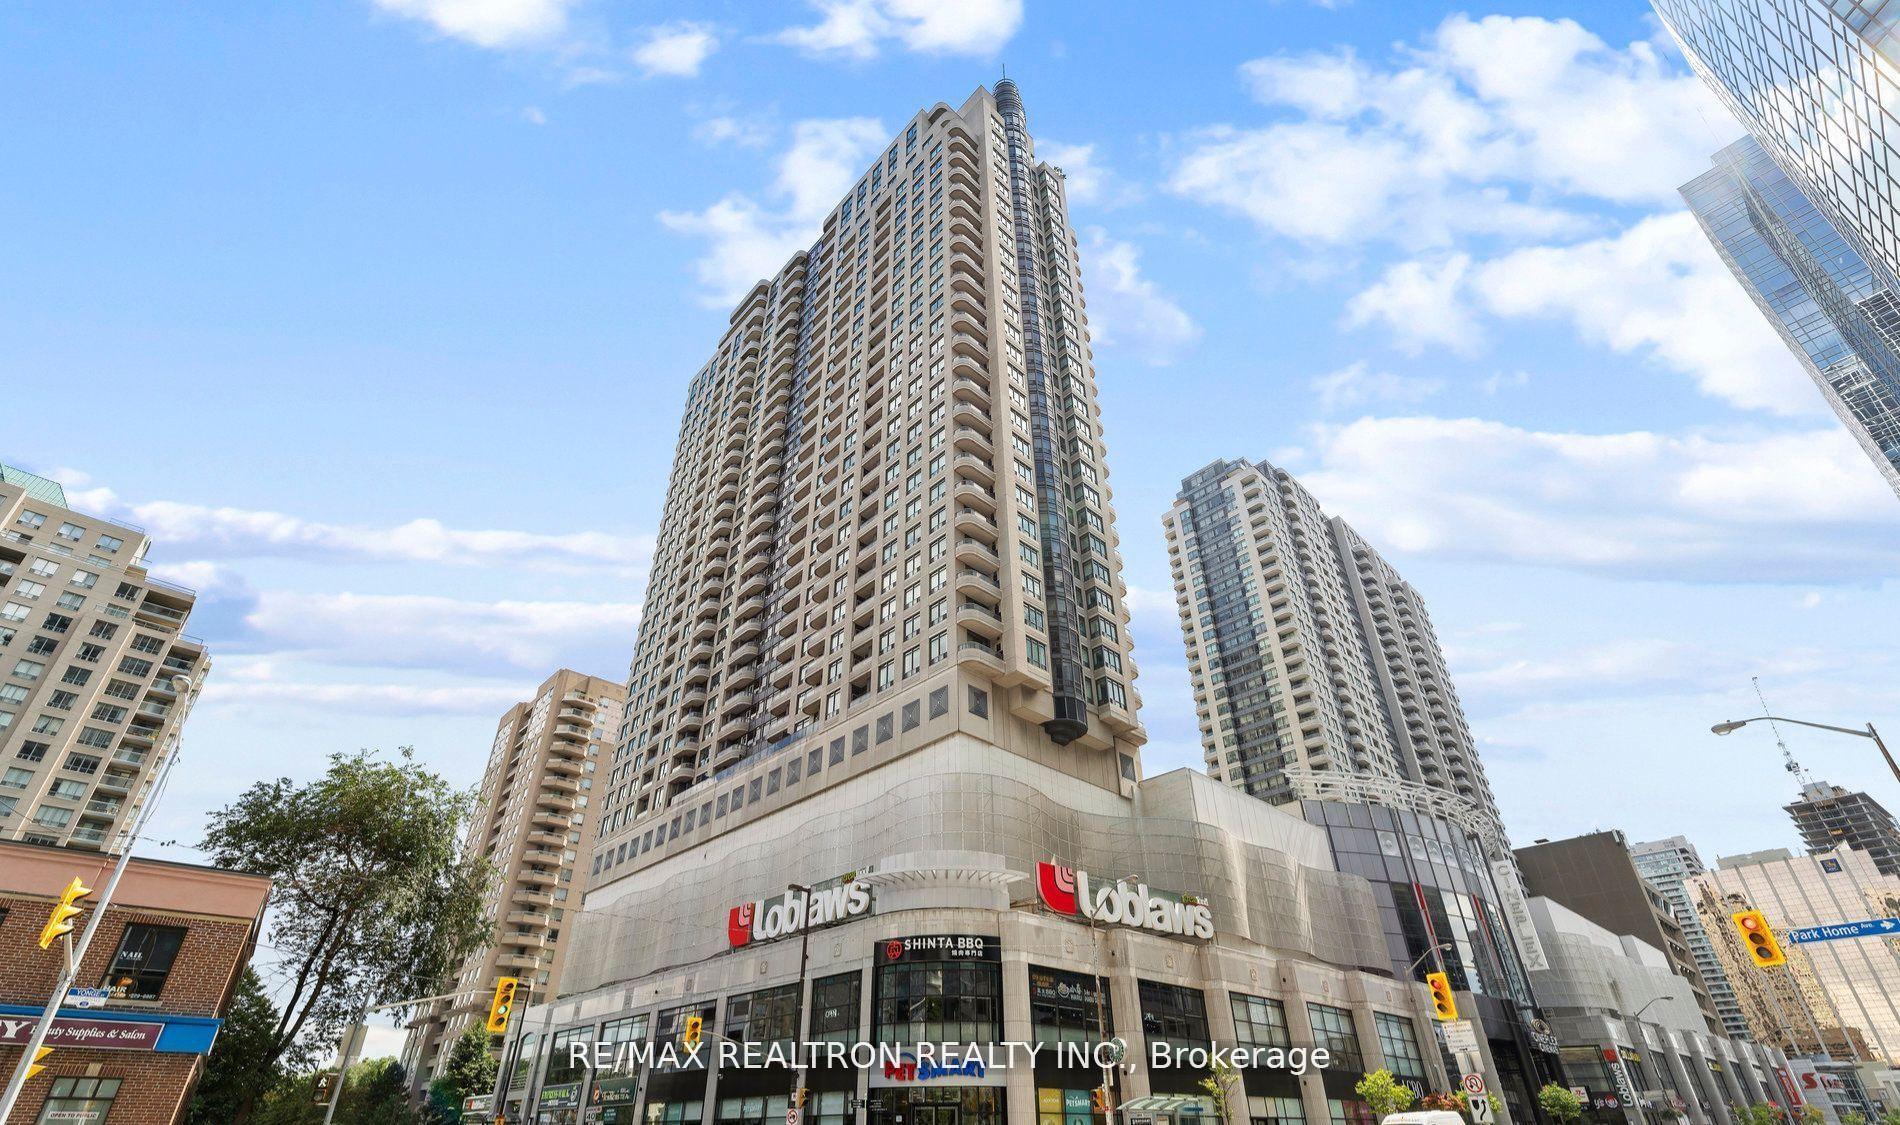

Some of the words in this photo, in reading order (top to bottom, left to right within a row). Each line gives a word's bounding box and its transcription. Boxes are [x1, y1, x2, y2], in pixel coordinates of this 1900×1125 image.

[752, 878, 870, 941] Loblaws
[1076, 870, 1215, 940] Loblaws
[1792, 929, 1820, 941] Park
[1823, 924, 1859, 938] Home
[904, 937, 954, 951] SHINTA
[957, 937, 984, 951] BBQ
[0, 1020, 31, 1039] Y
[66, 1027, 105, 1041] Supplies
[107, 1029, 119, 1039] &
[119, 1029, 146, 1040] Salon
[1401, 1080, 1424, 1099] CBO
[1611, 1062, 1634, 1108] Loblaws
